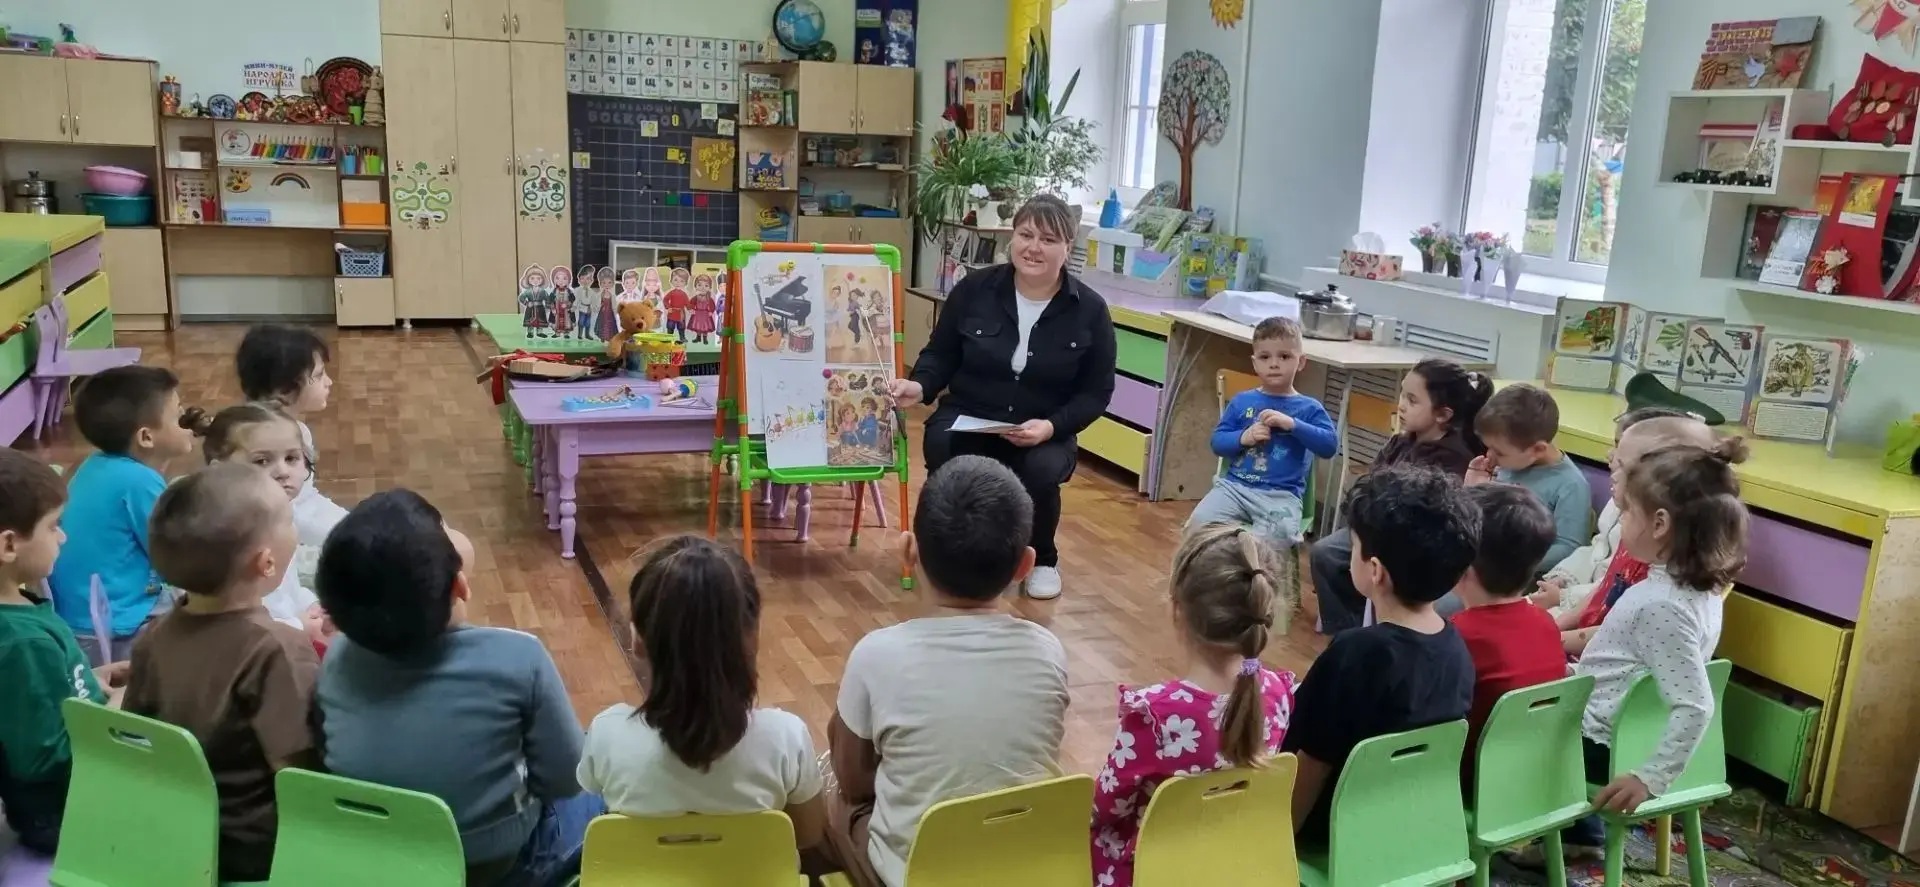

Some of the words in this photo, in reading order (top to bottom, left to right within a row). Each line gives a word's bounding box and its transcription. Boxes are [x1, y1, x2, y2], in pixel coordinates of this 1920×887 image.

[569, 32, 576, 40] А
[588, 33, 595, 41] Б
[608, 34, 615, 43] В
[627, 36, 634, 44] Г
[645, 37, 654, 46] Д
[666, 38, 672, 47] Е
[702, 41, 711, 49] Ж
[721, 42, 728, 51] З
[739, 43, 747, 52] И
[569, 53, 576, 62] К
[588, 54, 596, 63] Л
[607, 55, 616, 64] М
[627, 56, 635, 65] Н
[646, 57, 654, 66] О
[666, 58, 672, 67] П
[685, 60, 691, 68] Р
[703, 61, 710, 70] С
[721, 62, 728, 71] Т
[570, 74, 576, 82] Х
[588, 75, 596, 84] Ц
[609, 76, 615, 84] Ч
[626, 77, 636, 86] Ш
[645, 78, 656, 87] Щ
[665, 79, 674, 88] Ъ
[683, 80, 692, 89] Ы
[703, 81, 710, 90] Ь
[721, 83, 728, 91] Э
